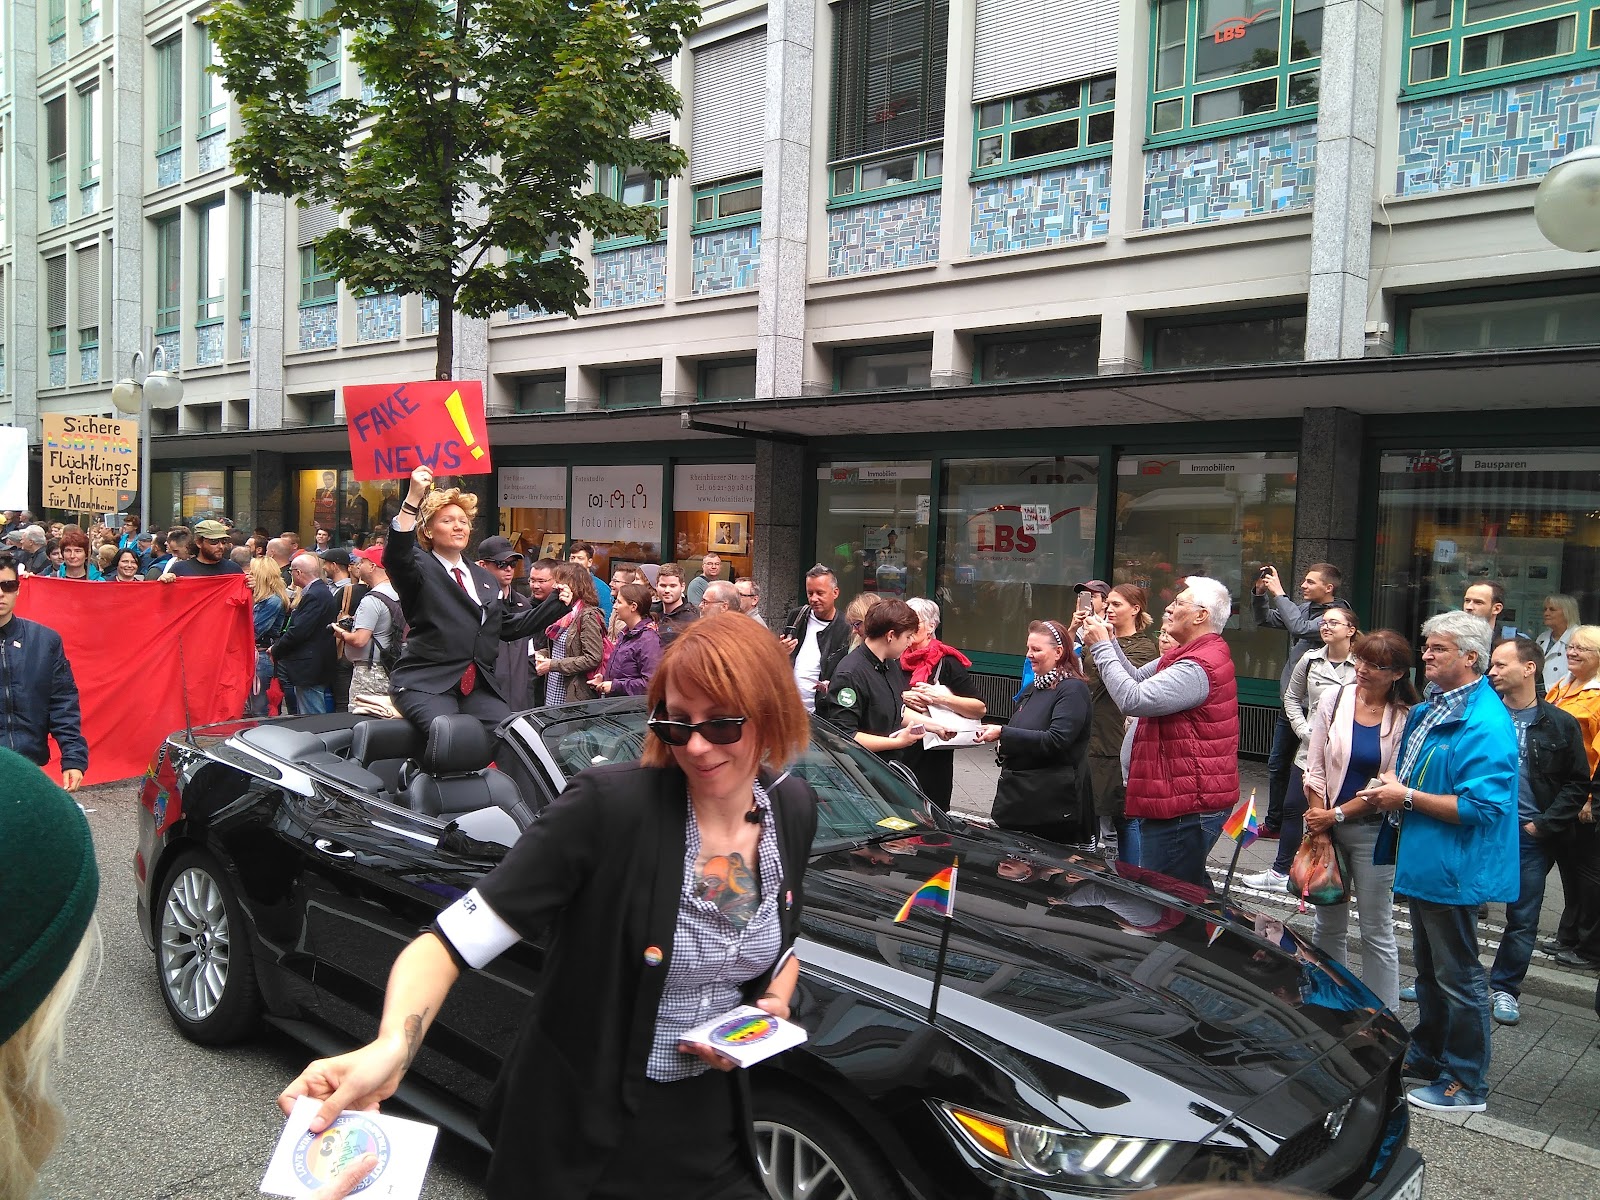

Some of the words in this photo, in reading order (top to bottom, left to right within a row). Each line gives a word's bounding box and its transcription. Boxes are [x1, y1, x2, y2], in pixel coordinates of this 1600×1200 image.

[1214, 24, 1246, 44] LBS
[352, 385, 421, 443] FAKE
[63, 416, 121, 436] Sichere
[47, 431, 133, 455] LSBTTIQ
[50, 450, 137, 477] Flüchtlings-
[373, 440, 461, 475] NEWS
[1474, 460, 1527, 470] Bausparen
[868, 470, 897, 478] Immobilien
[1191, 464, 1235, 472] Immobilien
[51, 469, 128, 488] unterkünfte
[696, 483, 706, 491] Tel.
[48, 492, 66, 507] für
[68, 493, 115, 512] Mannheim
[581, 516, 654, 530] fotoinitiative
[977, 525, 1037, 553] LBS
[296, 1132, 317, 1153] WINS
[295, 1152, 309, 1180] LOVE
